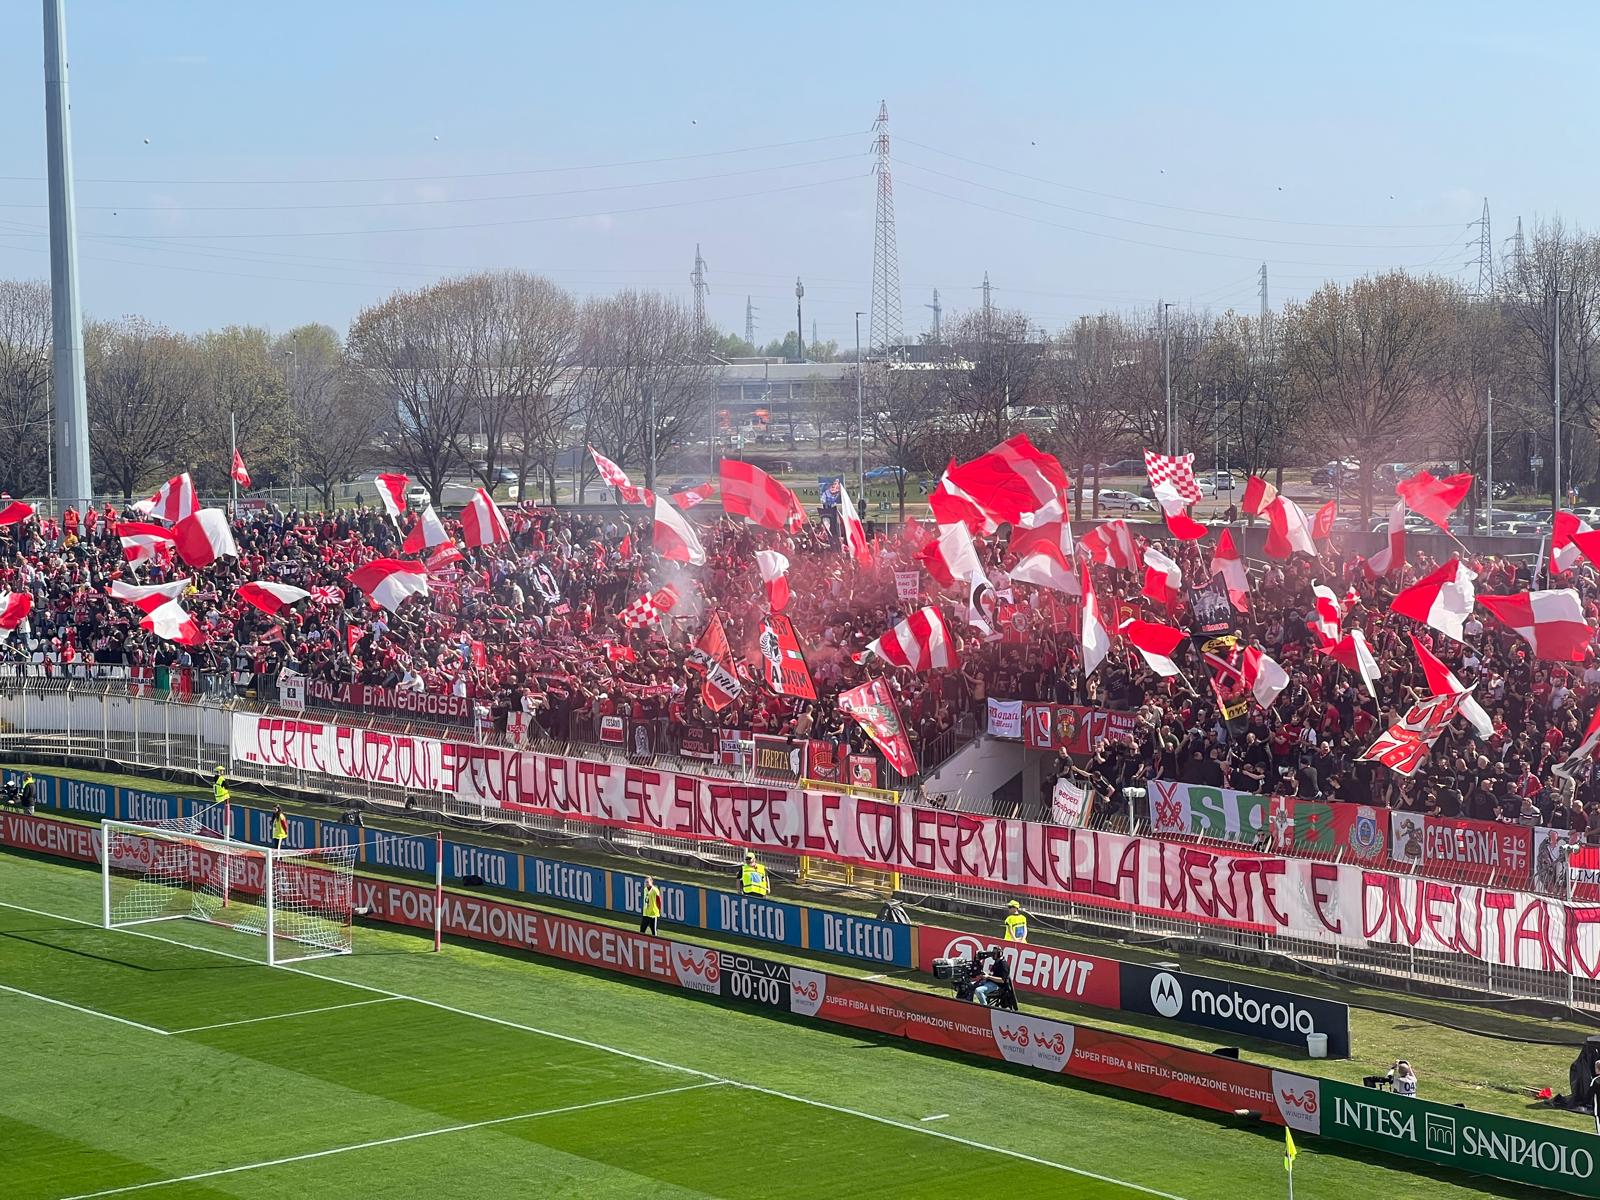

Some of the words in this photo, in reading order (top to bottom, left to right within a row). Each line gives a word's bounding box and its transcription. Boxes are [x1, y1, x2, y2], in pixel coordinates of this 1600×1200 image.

[8, 816, 93, 857] VINCENTE!
[441, 742, 613, 818] SPECIALMENTE
[625, 767, 662, 828] SE
[803, 792, 841, 854] LE
[855, 799, 1008, 881] CONSERVI
[1022, 821, 1141, 905] NELLA
[1159, 842, 1288, 927] MENTE
[1311, 862, 1341, 934] E
[1425, 824, 1500, 867] CEDERNA
[388, 888, 538, 945] FORMAZIONE
[543, 918, 672, 977] VINCENTE!
[720, 953, 790, 981] BOLVA
[731, 971, 780, 1005] 00:00
[825, 995, 848, 1008] SUPER
[849, 998, 869, 1012] FIBRA
[906, 1012, 954, 1031] FORMAZIONE
[954, 1021, 993, 1039] VINCENTE!
[1191, 988, 1315, 1034] motorola
[1074, 1047, 1100, 1063] SUPER
[1101, 1054, 1126, 1069] FIBRA
[1126, 1060, 1133, 1070] &
[1134, 1062, 1170, 1079] NETFLIX:
[1171, 1070, 1227, 1092] FORMAZIONE
[1229, 1083, 1274, 1103] VINCENTE!
[1334, 1096, 1418, 1143] INTESA
[1462, 1125, 1594, 1179] SANPAOLO
